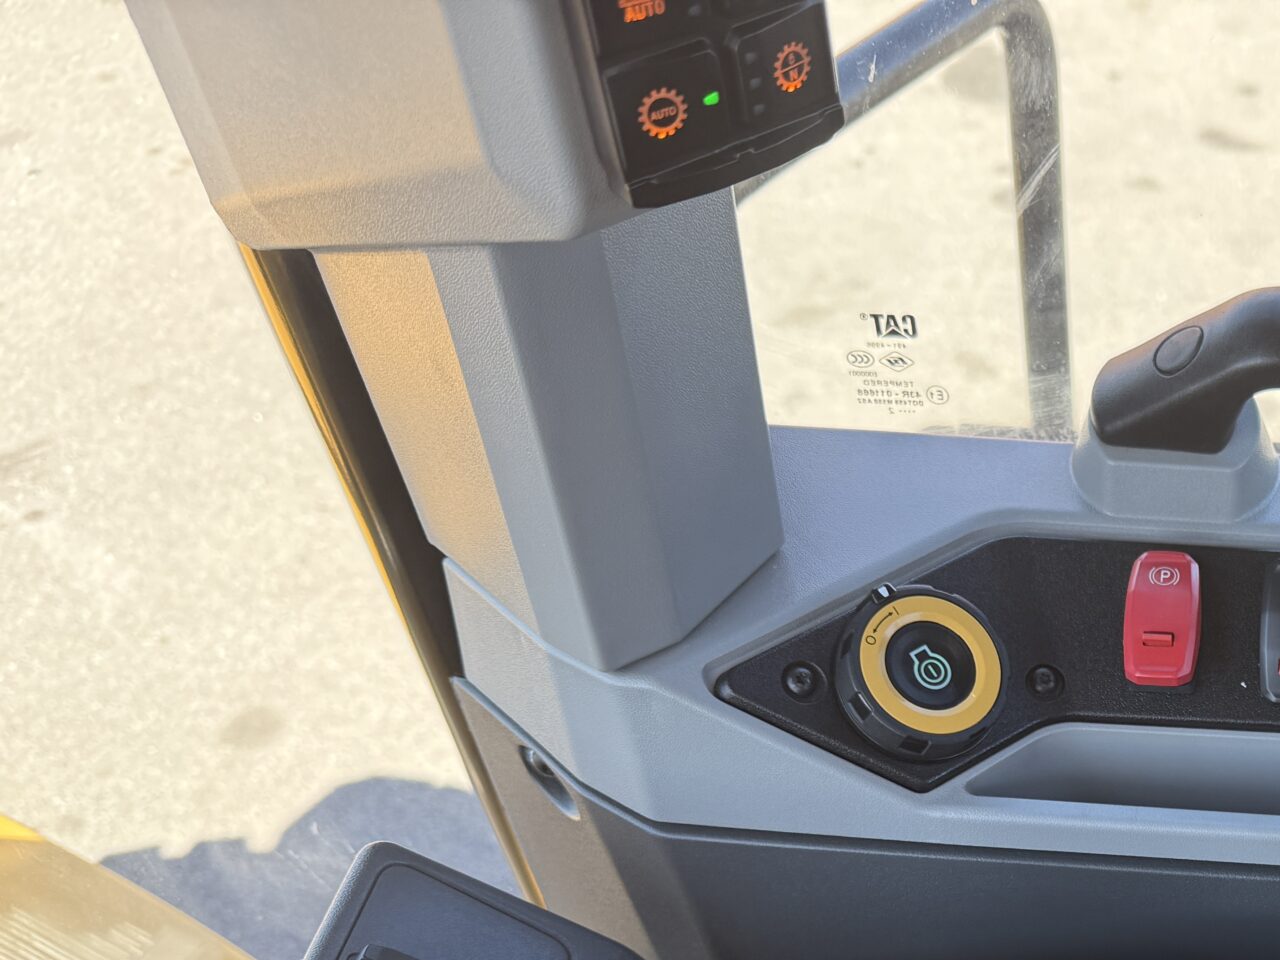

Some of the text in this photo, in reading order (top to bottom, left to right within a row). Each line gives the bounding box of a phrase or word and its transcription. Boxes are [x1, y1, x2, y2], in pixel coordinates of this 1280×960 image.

[623, 0, 665, 23] AUTO
[650, 106, 677, 121] AUTO
[1160, 570, 1171, 582] P
